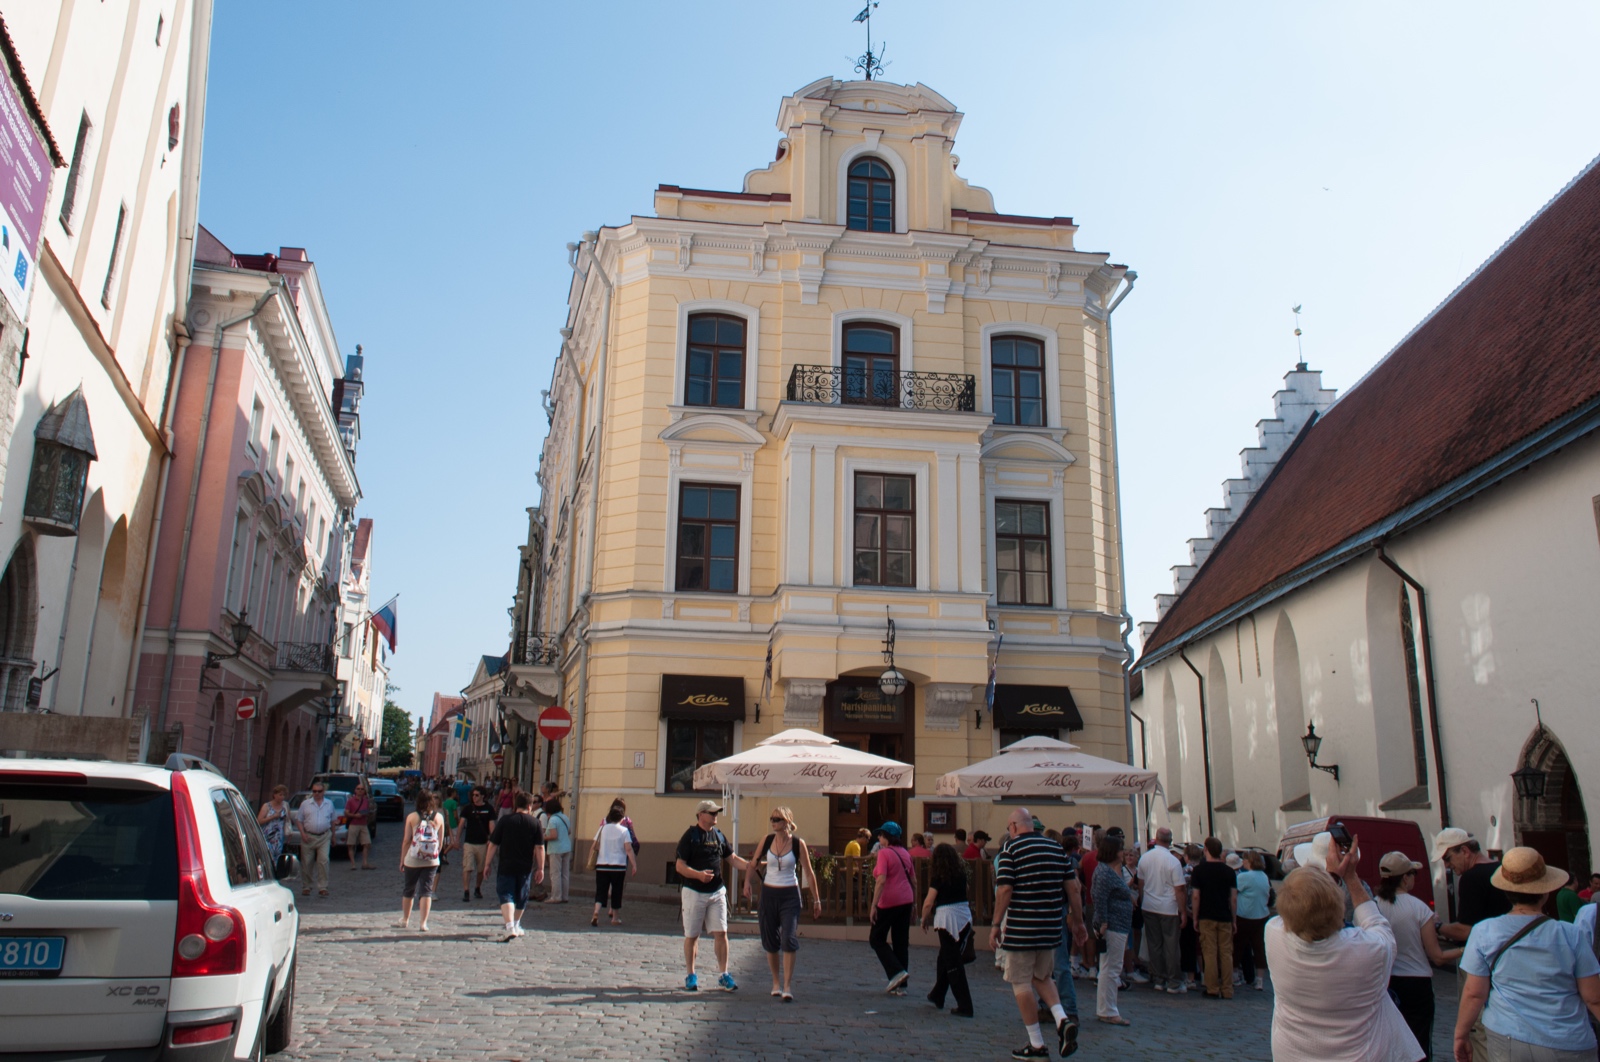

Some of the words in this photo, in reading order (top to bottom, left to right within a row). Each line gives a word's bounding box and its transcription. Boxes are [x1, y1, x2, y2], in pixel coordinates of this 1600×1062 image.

[677, 694, 730, 707] Kalev
[1016, 703, 1065, 716] Kalev
[0, 941, 50, 966] 810
[106, 985, 132, 996] XC
[134, 985, 160, 996] 90
